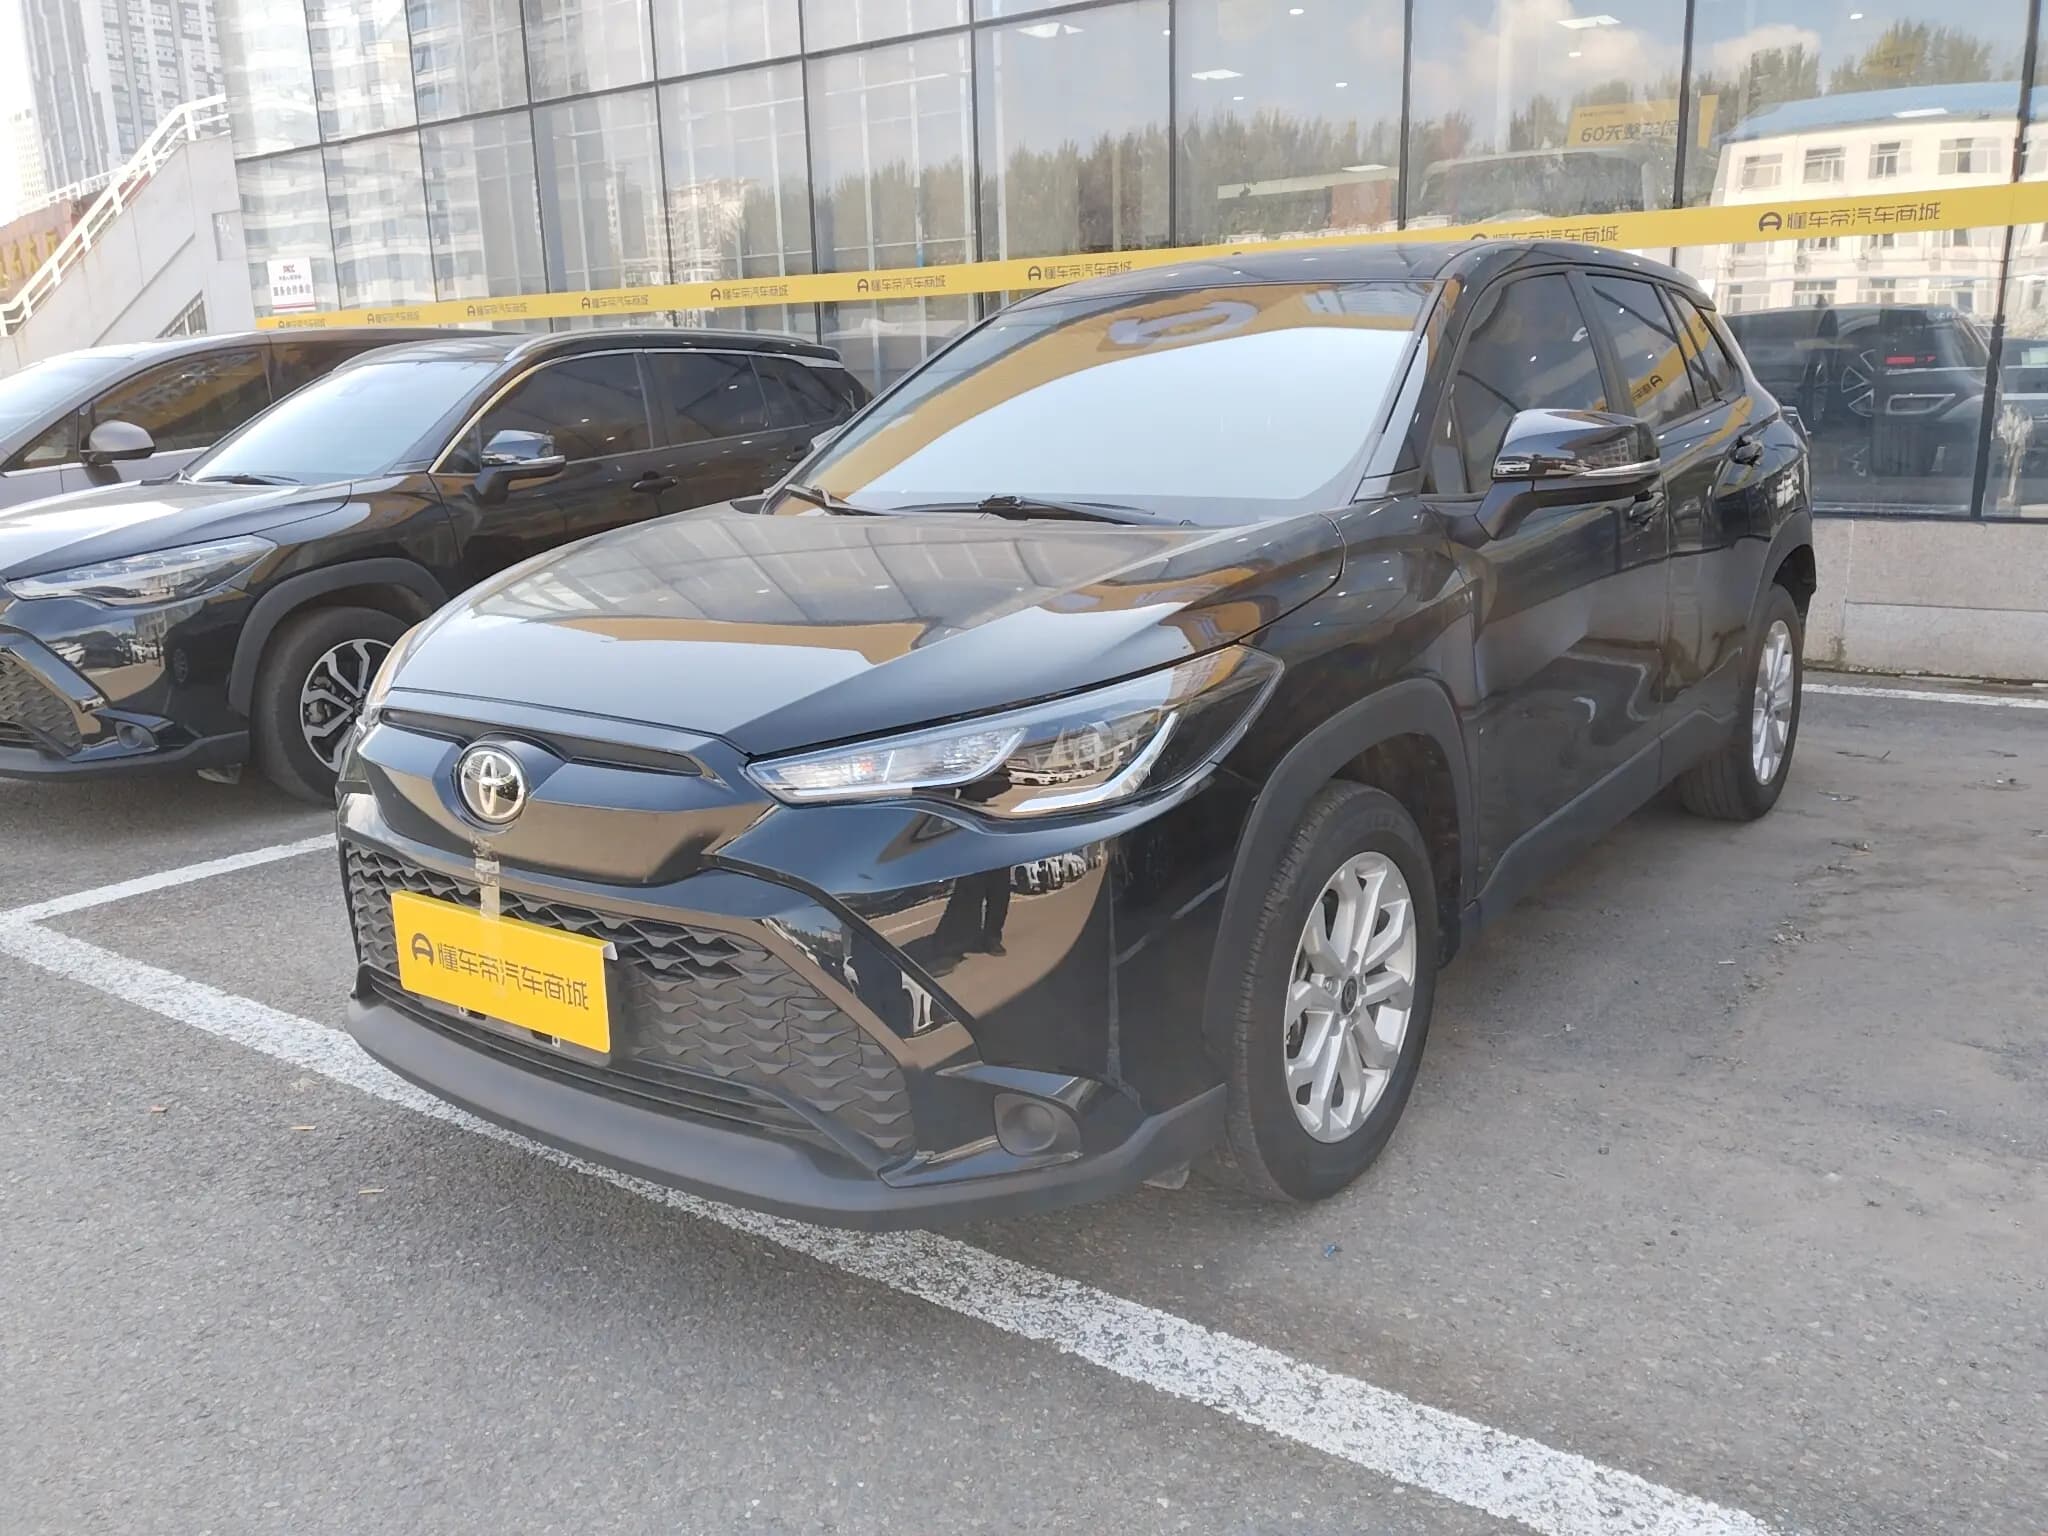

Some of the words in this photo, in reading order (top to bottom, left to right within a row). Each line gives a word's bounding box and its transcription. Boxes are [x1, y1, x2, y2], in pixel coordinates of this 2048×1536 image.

[1787, 202, 1941, 230] 懂车帝汽车商城
[437, 942, 589, 1010] 懂车帝汽车商城
